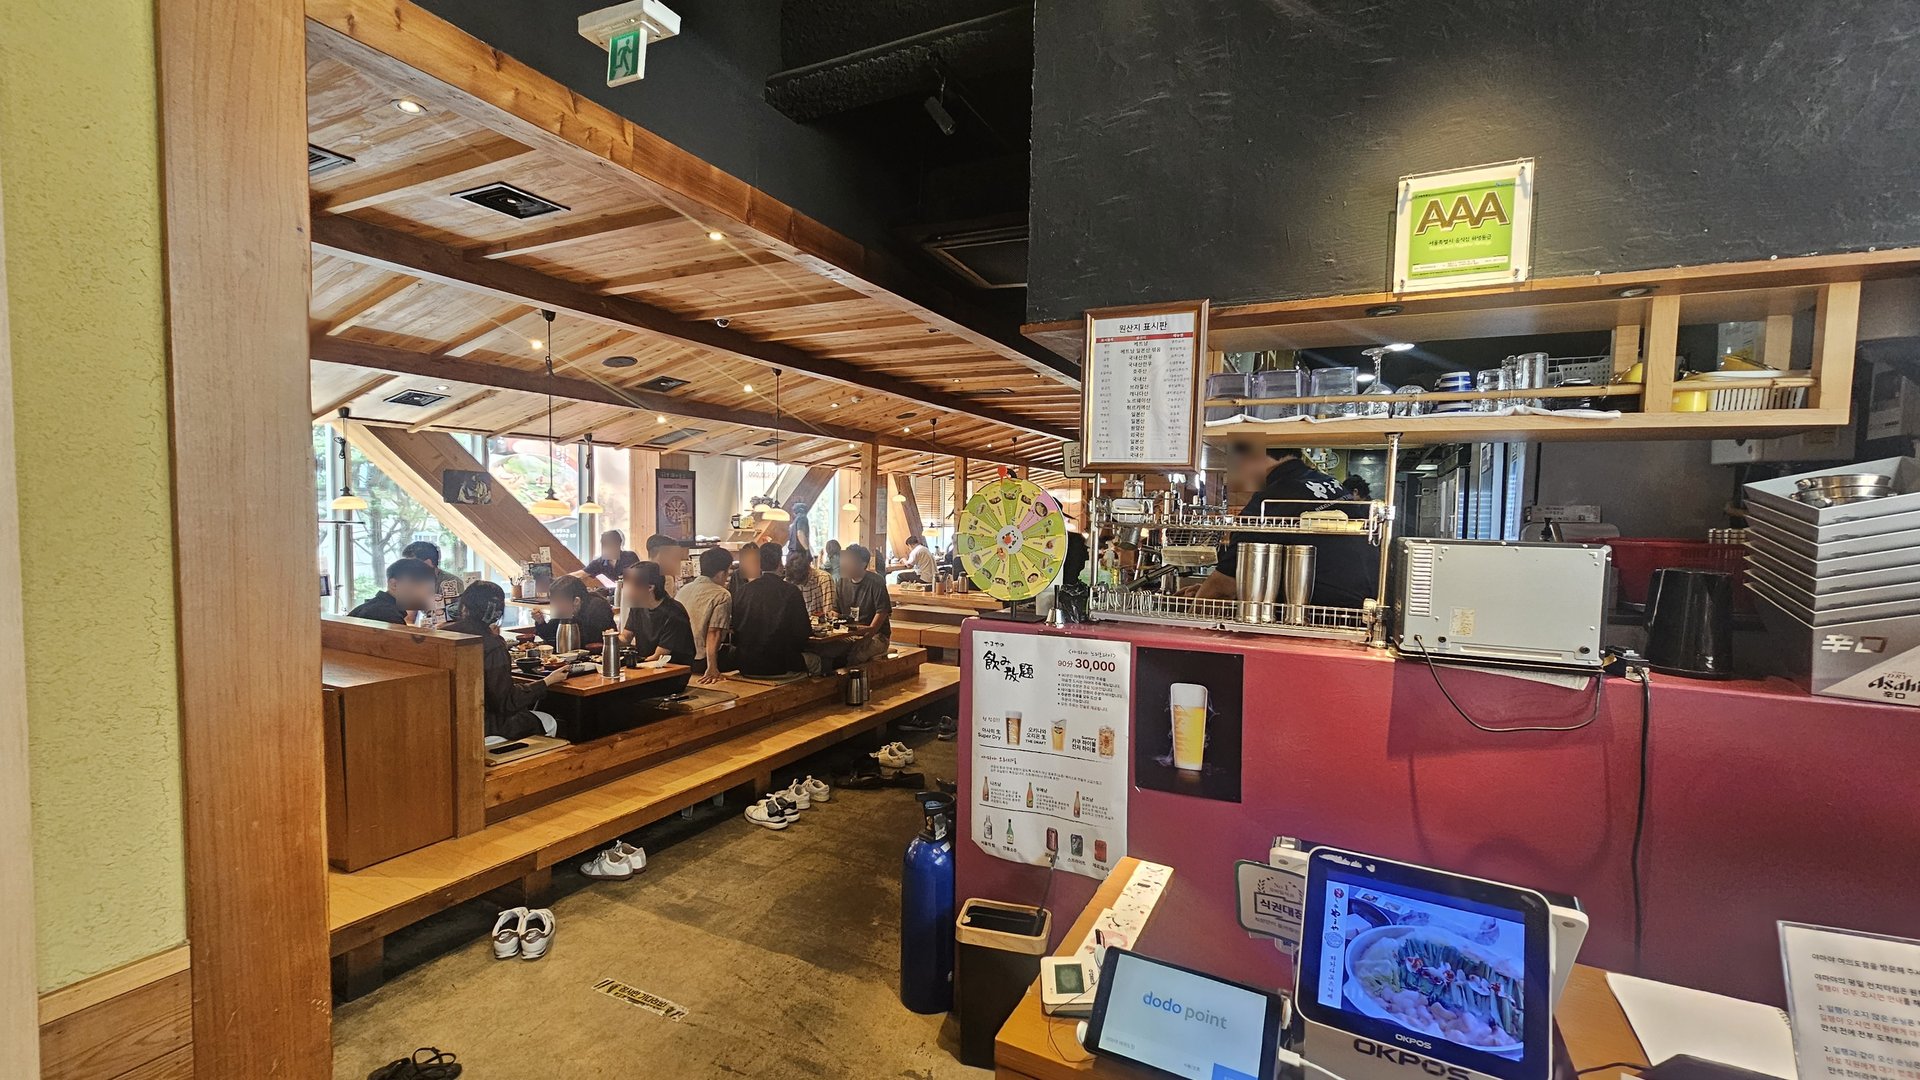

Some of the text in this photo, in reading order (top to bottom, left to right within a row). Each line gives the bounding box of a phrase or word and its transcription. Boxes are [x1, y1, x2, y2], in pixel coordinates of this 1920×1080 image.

[1415, 191, 1510, 235] AAA
[1119, 321, 1168, 333] 원산지 표시판
[1821, 633, 1888, 653] 辛口
[1057, 658, 1116, 672] 90分 30,000
[1868, 676, 1920, 693] Asahi
[1082, 739, 1096, 748] 하이볼
[1082, 745, 1096, 753] 하이볼
[1142, 990, 1228, 1030] dodo point
[1395, 1033, 1433, 1050] OKPOS
[1353, 1038, 1472, 1080] OKPOS
